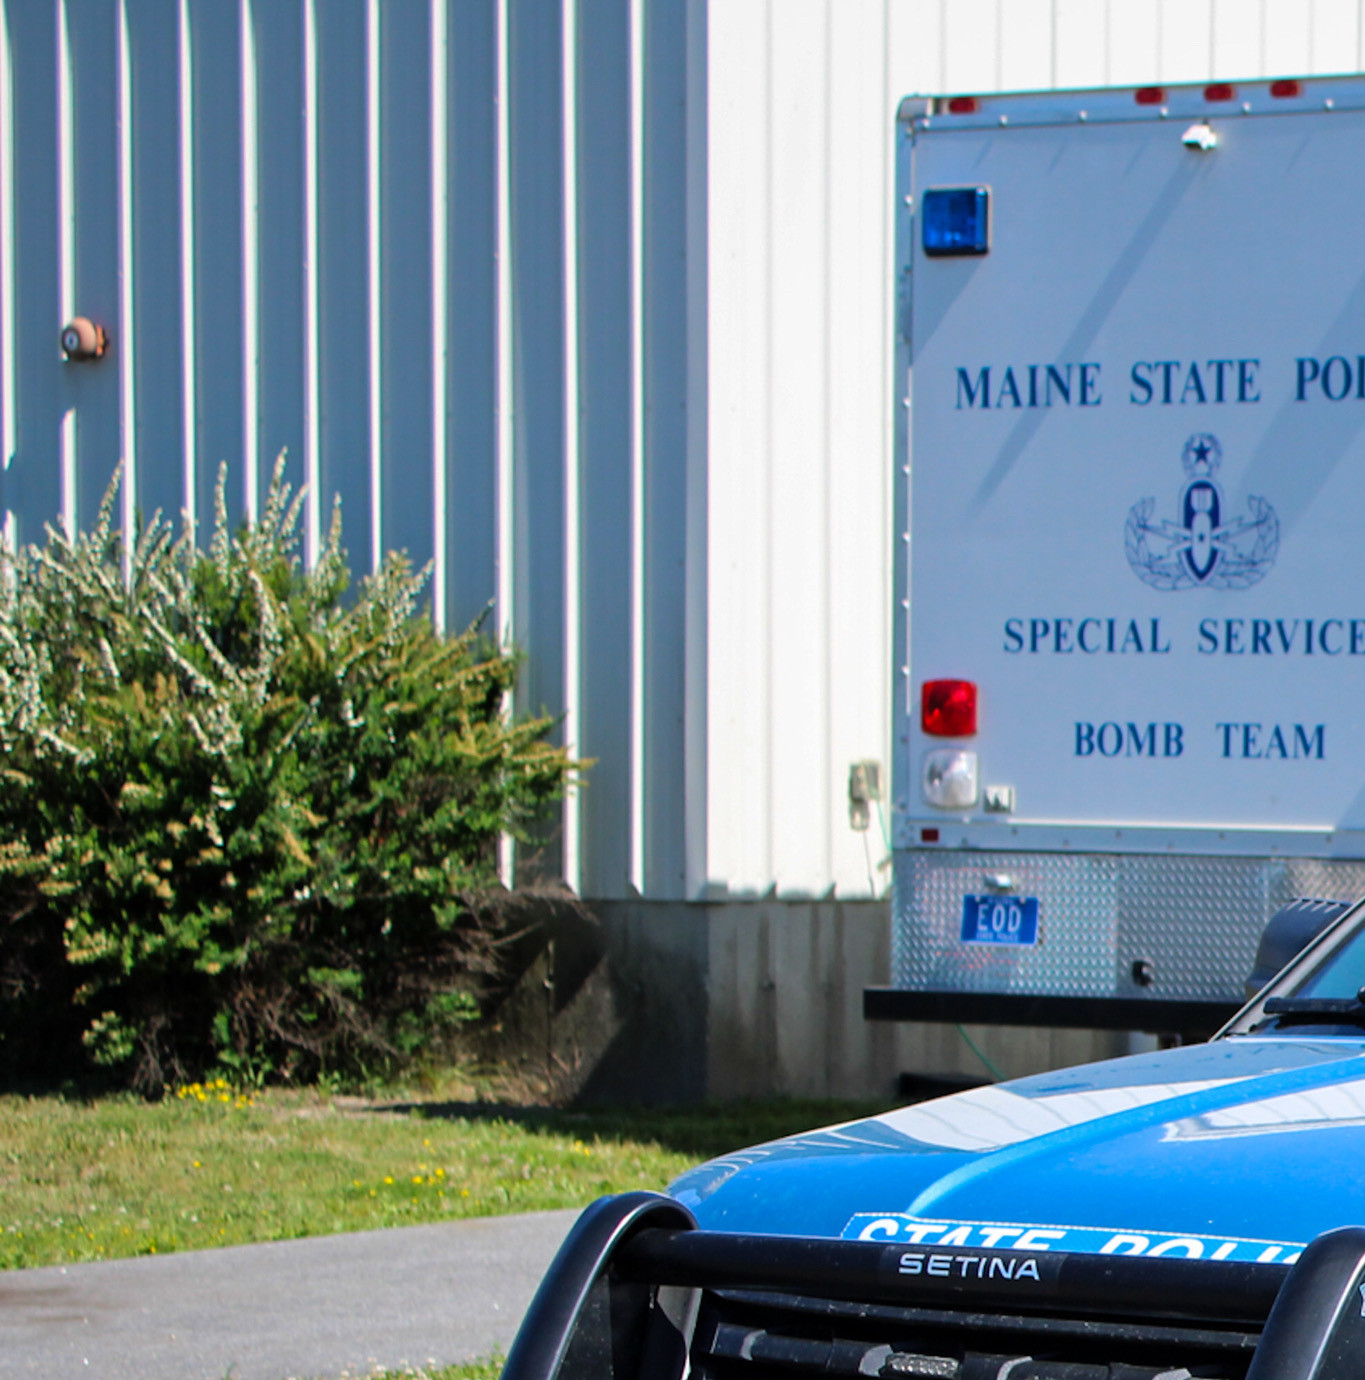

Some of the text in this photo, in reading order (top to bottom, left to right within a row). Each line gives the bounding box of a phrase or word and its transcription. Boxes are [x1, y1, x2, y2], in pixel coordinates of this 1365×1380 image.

[955, 362, 1102, 410] MAINE
[1129, 358, 1261, 406] STATE
[1003, 617, 1170, 655] SPECIAL
[1074, 722, 1326, 760] BOMB TEAM
[977, 904, 1022, 932] EOD
[897, 1253, 1040, 1281] SETINA
